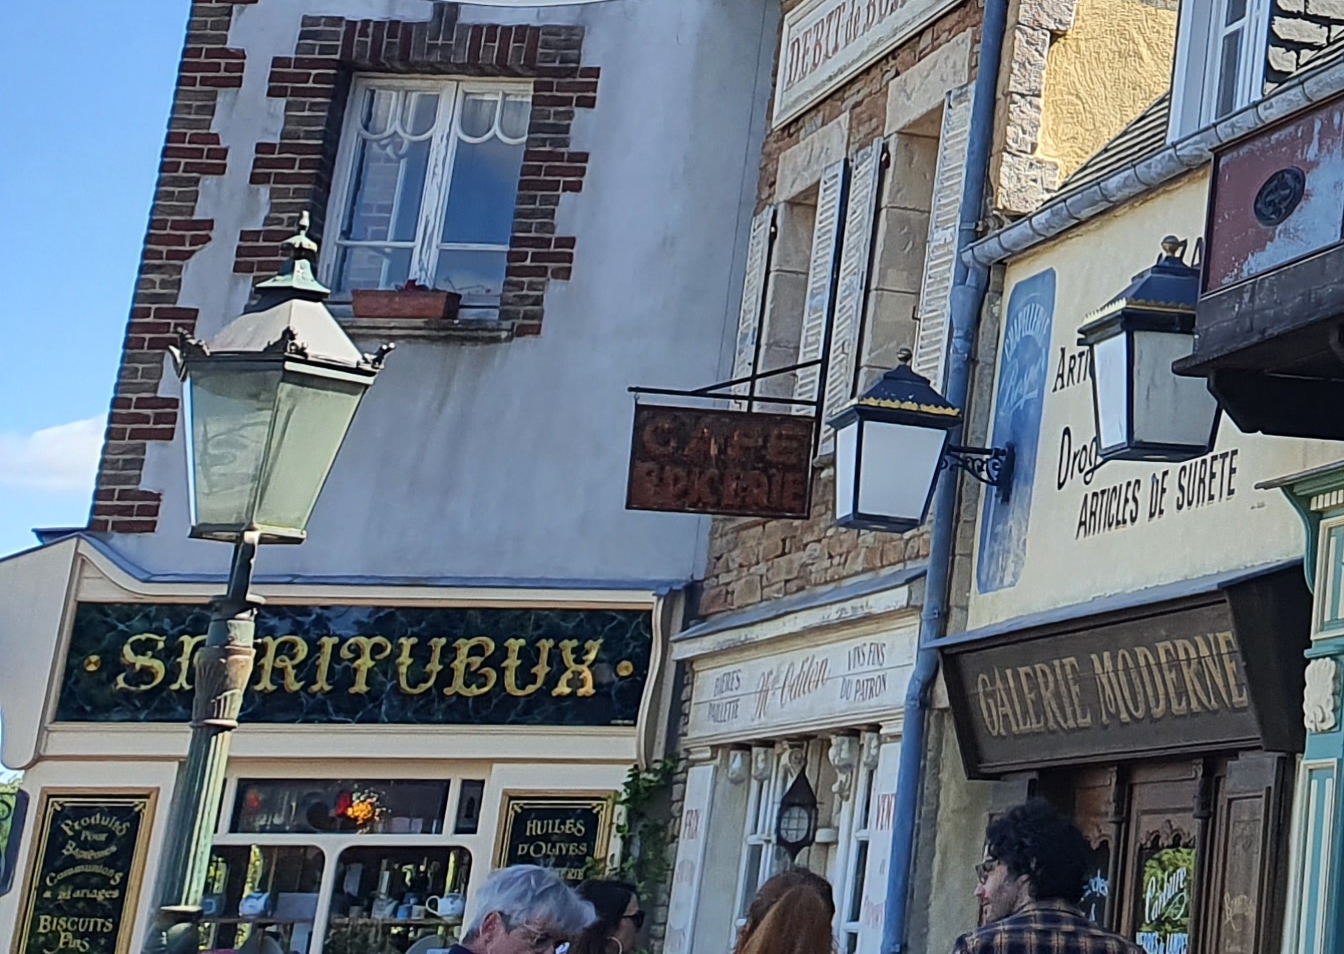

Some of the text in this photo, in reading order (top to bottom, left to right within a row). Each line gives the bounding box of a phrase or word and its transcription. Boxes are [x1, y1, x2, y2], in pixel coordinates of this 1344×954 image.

[1076, 449, 1239, 539] ARTICLES DE SURETE
[854, 672, 887, 702] PATRON
[977, 631, 1248, 736] GALERIE MODERNE
[526, 819, 586, 837] HUILES
